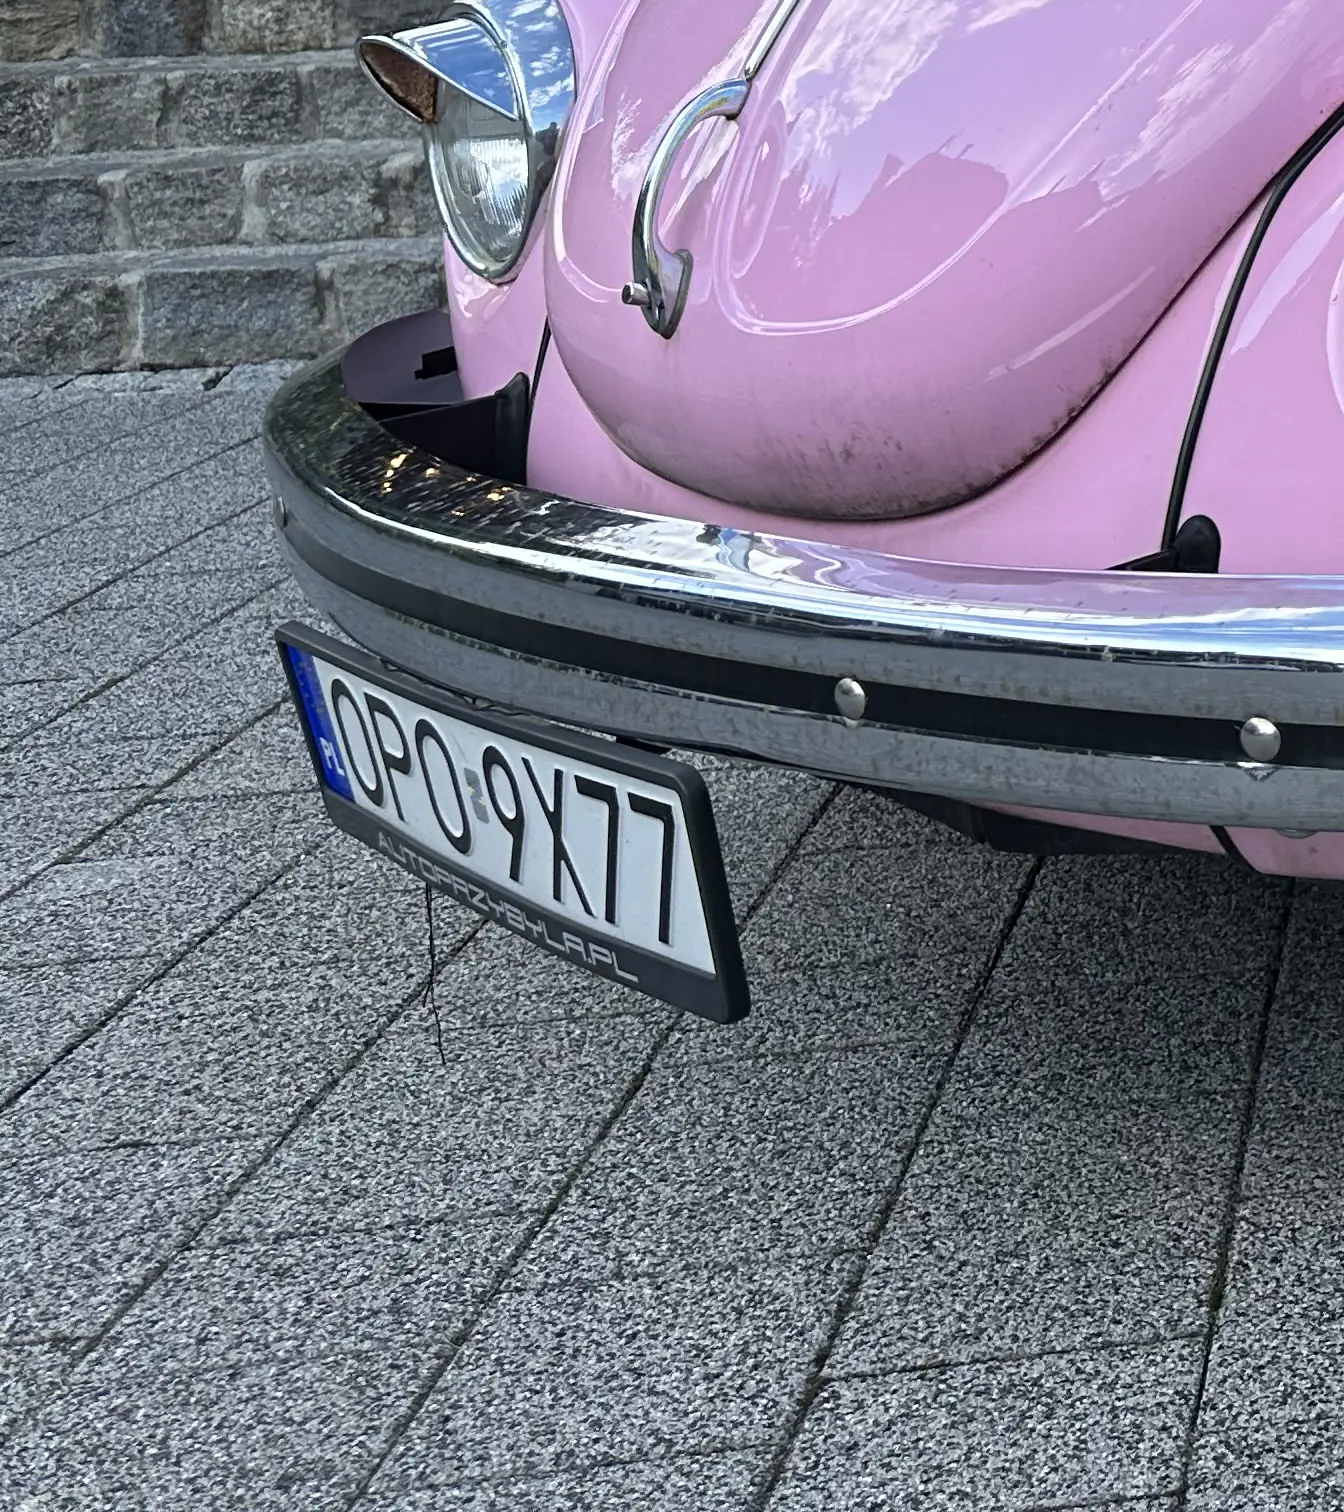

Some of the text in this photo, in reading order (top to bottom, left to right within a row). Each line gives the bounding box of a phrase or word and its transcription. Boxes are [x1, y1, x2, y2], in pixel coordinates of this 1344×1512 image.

[319, 736, 346, 777] PL
[331, 677, 675, 946] OPO 9X77
[378, 830, 639, 984] AUTOPRZYBYLA.PL
